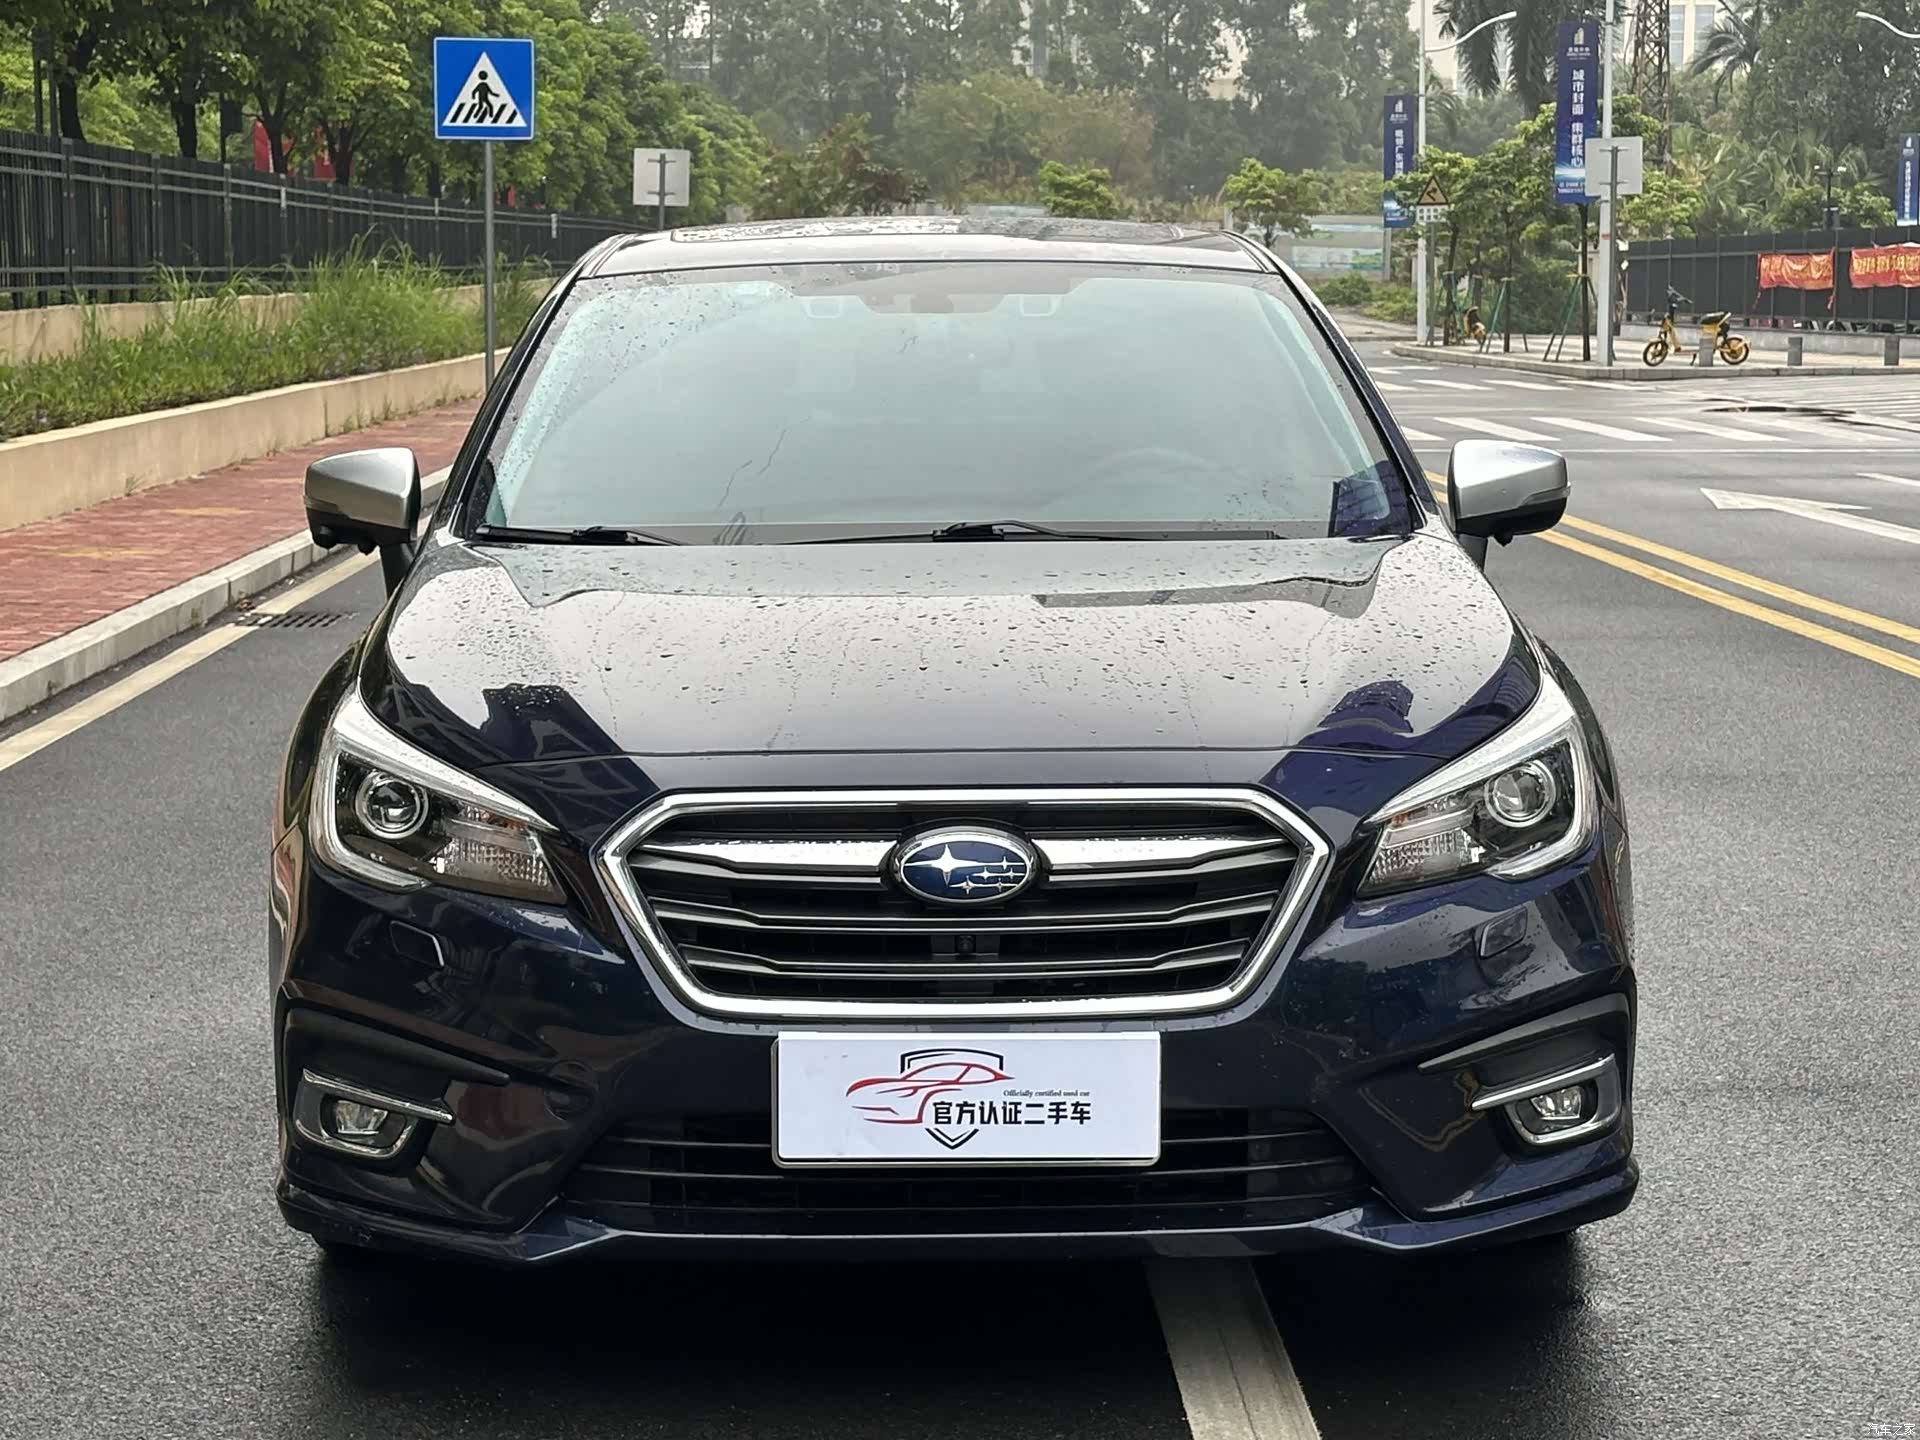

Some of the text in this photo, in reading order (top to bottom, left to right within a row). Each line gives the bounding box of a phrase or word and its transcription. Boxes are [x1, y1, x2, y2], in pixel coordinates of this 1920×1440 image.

[1003, 1089, 1033, 1098] Officially
[1034, 1089, 1062, 1097] certified
[932, 1101, 1091, 1125] 官方认证二手车
